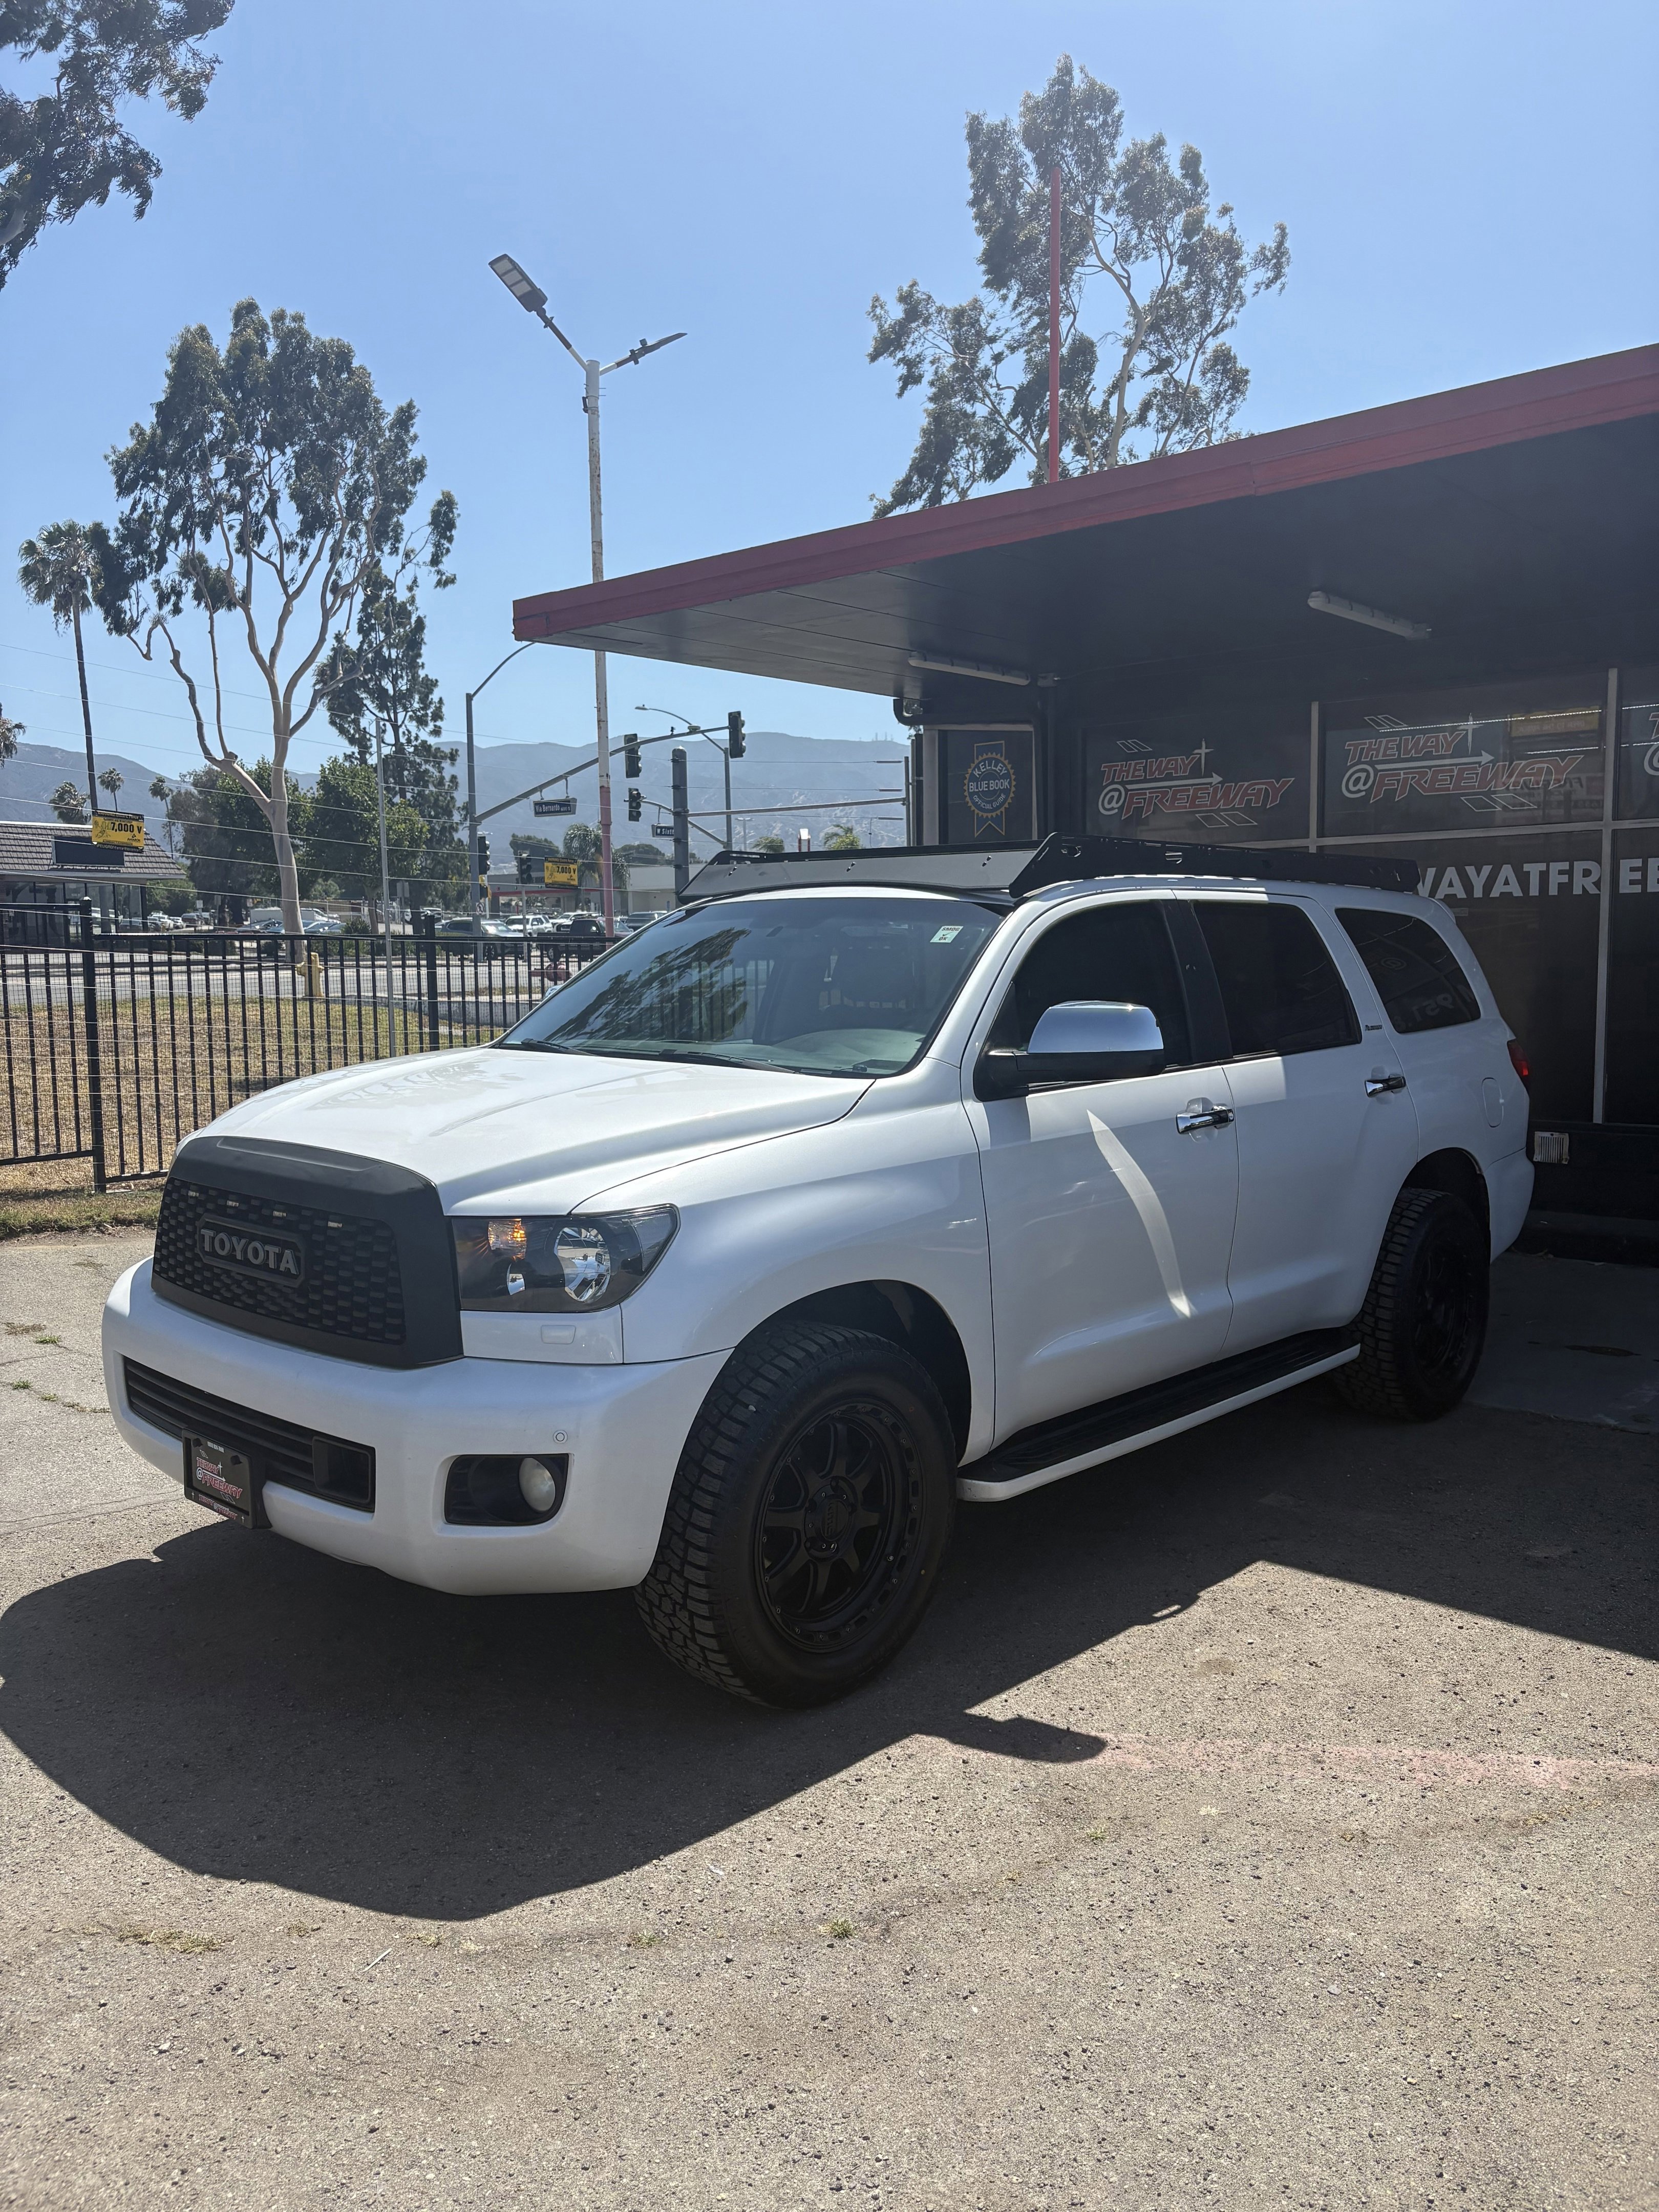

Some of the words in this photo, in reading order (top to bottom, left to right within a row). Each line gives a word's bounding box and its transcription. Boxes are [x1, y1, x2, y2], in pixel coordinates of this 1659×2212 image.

[1345, 737, 1399, 765] THE
[1401, 731, 1466, 758] WAY
[973, 760, 1007, 778] KELLEY
[1101, 760, 1145, 786] THE
[1146, 754, 1201, 778] WAY
[969, 781, 988, 792] BLUE
[989, 779, 1010, 790] BOOK
[543, 803, 560, 812] Bernardo
[973, 795, 993, 809] OFFICIAL
[992, 793, 1006, 807] GUIDE
[111, 822, 134, 833] 7,000
[137, 826, 142, 834] V
[557, 866, 571, 874] 7,000
[200, 1228, 299, 1275] TOYOTA
